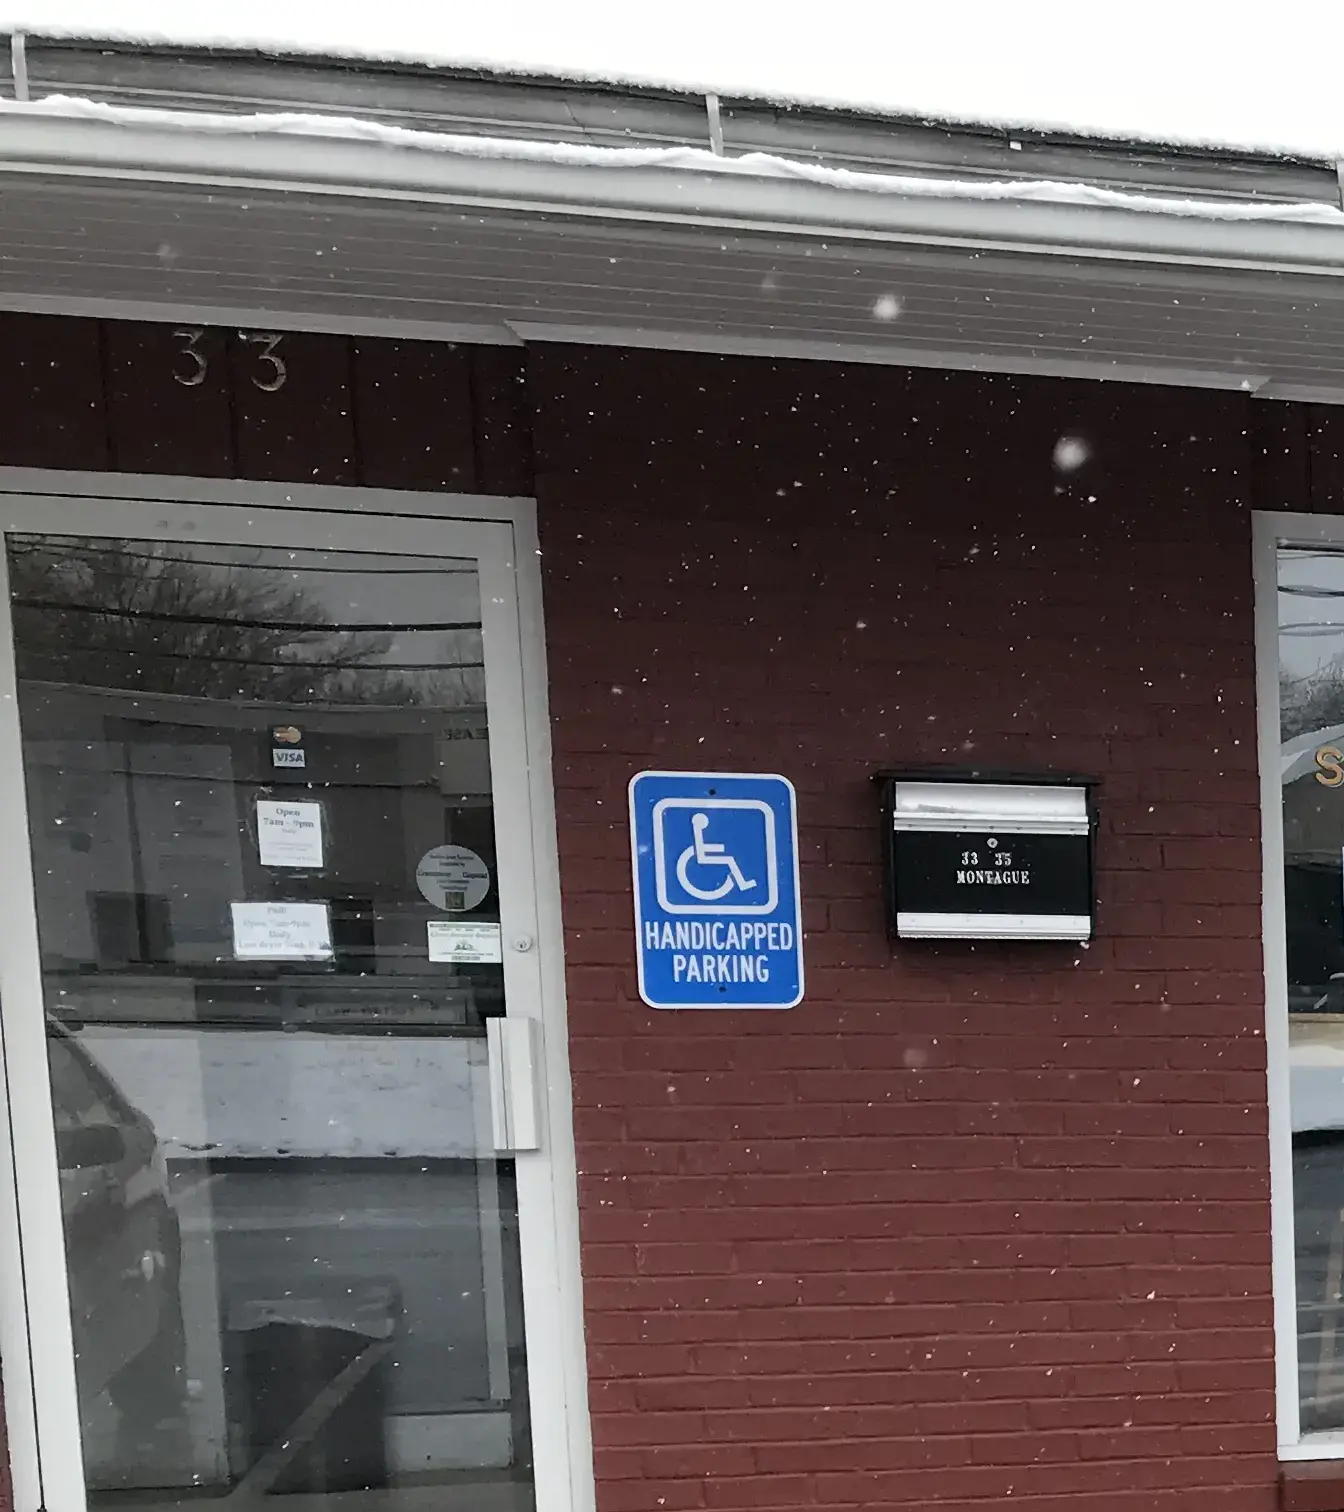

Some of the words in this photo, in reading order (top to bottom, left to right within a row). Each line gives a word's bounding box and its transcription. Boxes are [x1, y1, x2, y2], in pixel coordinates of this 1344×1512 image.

[274, 752, 304, 762] VISA
[275, 807, 301, 818] Open
[961, 851, 979, 866] 33
[994, 852, 1012, 866] 35
[956, 870, 1030, 885] MONTAGUE
[645, 921, 794, 951] HANDICAPPED
[673, 954, 770, 983] PARKING
